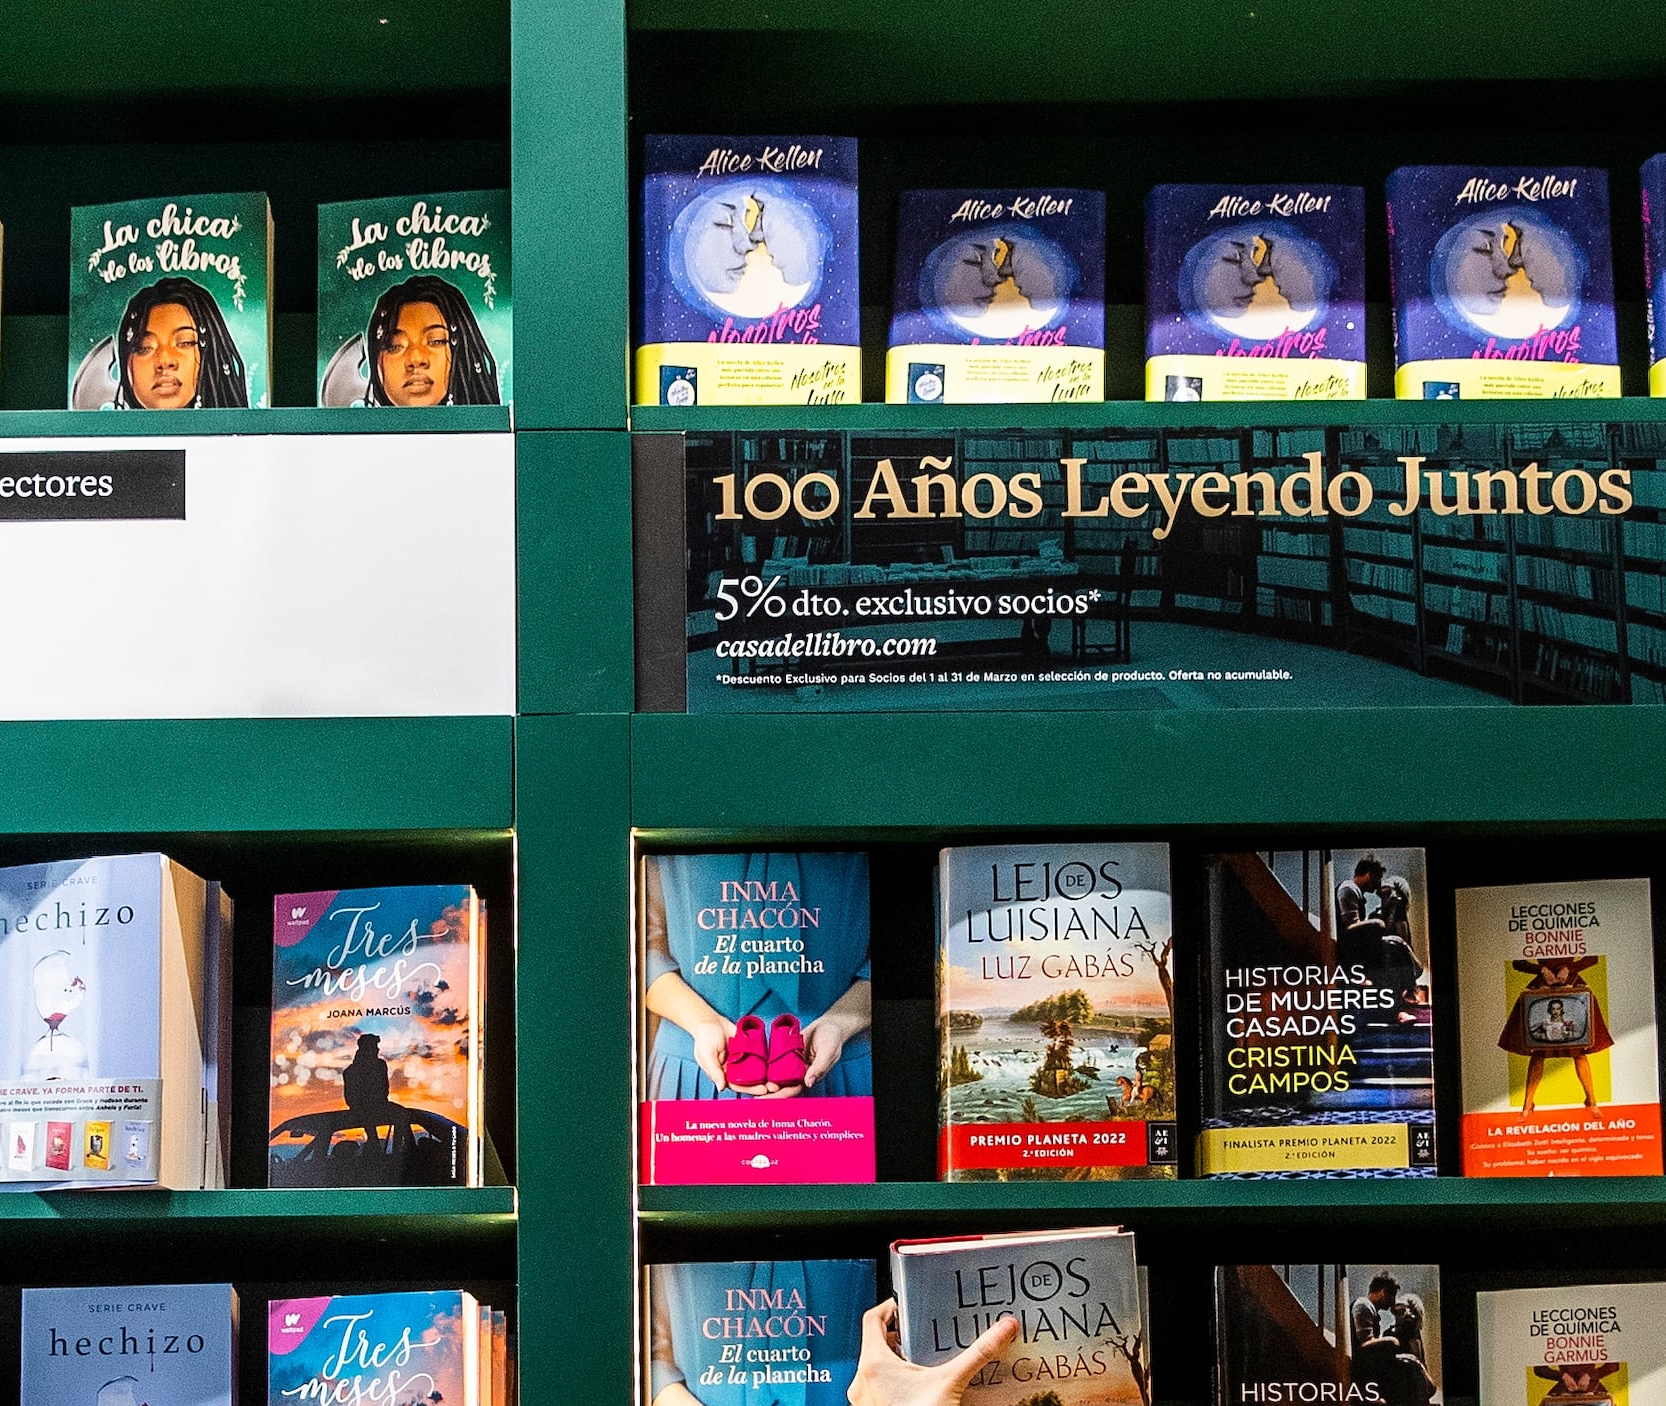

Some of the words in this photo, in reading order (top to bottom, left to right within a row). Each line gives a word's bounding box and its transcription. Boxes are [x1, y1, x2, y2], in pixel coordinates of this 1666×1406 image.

[698, 148, 752, 176] Alice
[758, 145, 823, 173] Kellen
[102, 218, 139, 255] La
[145, 203, 233, 239] chica
[103, 261, 128, 282] de
[129, 253, 153, 272] los
[155, 239, 241, 276] libros
[713, 472, 839, 521] 100
[854, 454, 1043, 520] Años
[1059, 451, 1373, 540] Leyendo
[1388, 456, 1632, 517] Juntos
[714, 575, 786, 622] 5%
[792, 589, 848, 618] dto.
[855, 588, 992, 617] exclusivo
[715, 633, 936, 658] casadellibro.com
[785, 673, 836, 684] Exclusivo
[841, 675, 865, 686] para
[869, 672, 905, 684] Socios
[909, 672, 925, 682] del
[929, 672, 934, 682] 1
[938, 672, 947, 682] al
[951, 672, 964, 682] 31
[967, 672, 980, 682] de
[983, 672, 1017, 682] Marzo
[1021, 674, 1034, 682] en
[1038, 670, 1090, 682] selección
[1094, 670, 1108, 681] de
[1111, 670, 1164, 685] producto.
[1169, 669, 1203, 680] Oferta
[1208, 672, 1221, 680] no
[1225, 669, 1293, 680] acumulable.
[992, 861, 1122, 903] LEJOS
[1065, 872, 1085, 887] DE
[1511, 902, 1596, 918] LECCIONES
[967, 905, 1150, 944] LUISIANA
[1509, 920, 1529, 932] DE
[1525, 929, 1584, 944] BONNIE
[1522, 943, 1587, 958] GARMUS
[981, 957, 1031, 980] LUZ
[1041, 948, 1134, 979] GABÁS
[1225, 964, 1365, 989] HISTORIAS
[1225, 990, 1264, 1012] DE
[1271, 988, 1394, 1012] MUJERES
[1225, 1014, 1356, 1038] CASADAS
[1227, 1045, 1356, 1070] CRISTINA
[1228, 1071, 1350, 1095] CAMPOS
[970, 1133, 1023, 1147] PREMIO
[1027, 1133, 1088, 1146] PLANETA
[1092, 1132, 1126, 1145] 2022
[89, 1303, 122, 1313] SERIE
[127, 1302, 166, 1312] CRAVE
[725, 1288, 805, 1310] INMA
[702, 1309, 826, 1338] CHACÓN
[49, 1327, 205, 1361] hechizo
[719, 1345, 742, 1364] El
[746, 1346, 811, 1362] cuarto
[700, 1365, 722, 1385] de
[727, 1365, 749, 1384] la
[752, 1364, 831, 1388] plancha
